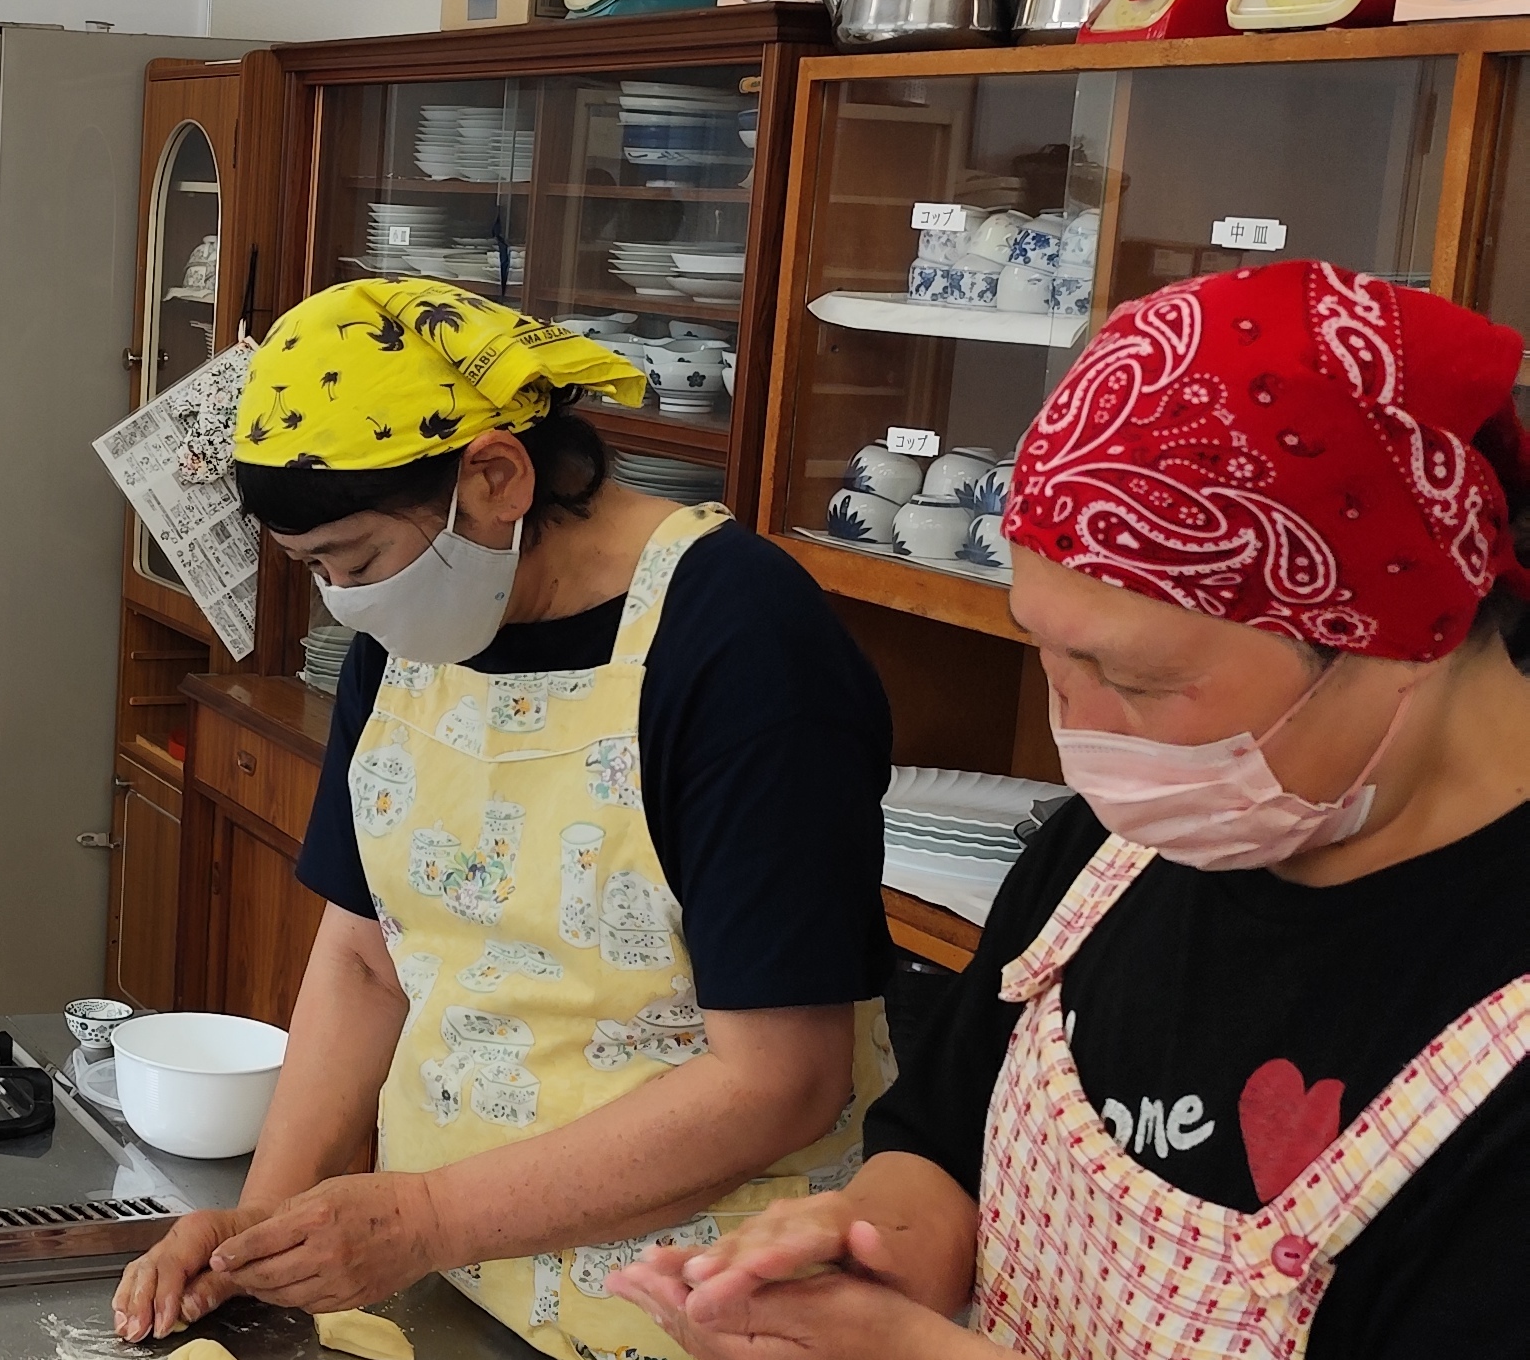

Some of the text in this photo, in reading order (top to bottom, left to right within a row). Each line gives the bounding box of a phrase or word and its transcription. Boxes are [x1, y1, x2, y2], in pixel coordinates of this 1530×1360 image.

[920, 208, 955, 227] コップ
[1230, 221, 1269, 245] 中皿
[542, 327, 574, 340] ISLAN
[895, 434, 929, 452] コップ
